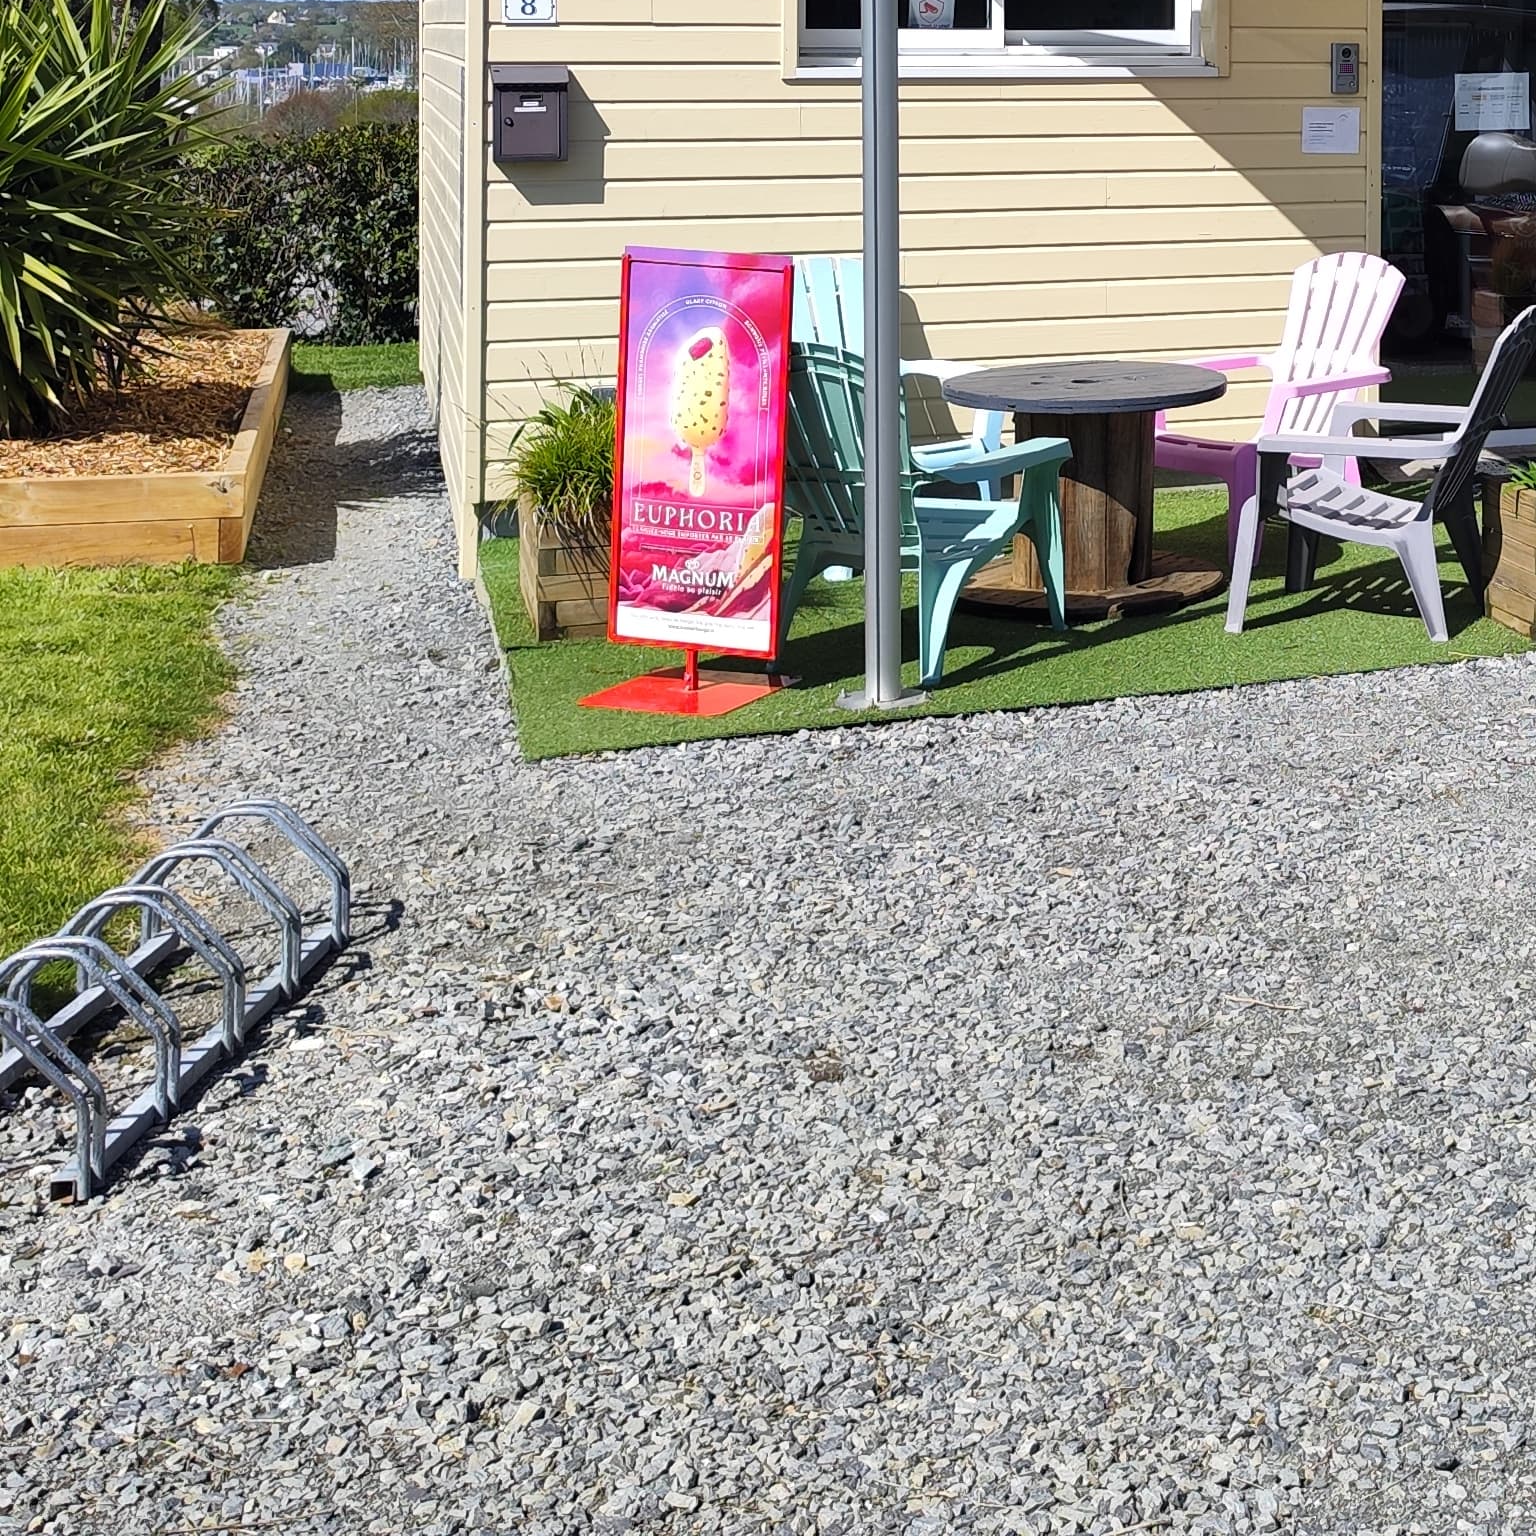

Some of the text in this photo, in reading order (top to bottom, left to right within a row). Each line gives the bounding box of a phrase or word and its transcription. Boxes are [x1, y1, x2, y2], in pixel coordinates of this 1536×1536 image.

[633, 501, 761, 533] EUPHORIA
[652, 563, 735, 588] MAGNUM
[698, 584, 723, 597] plaisir
